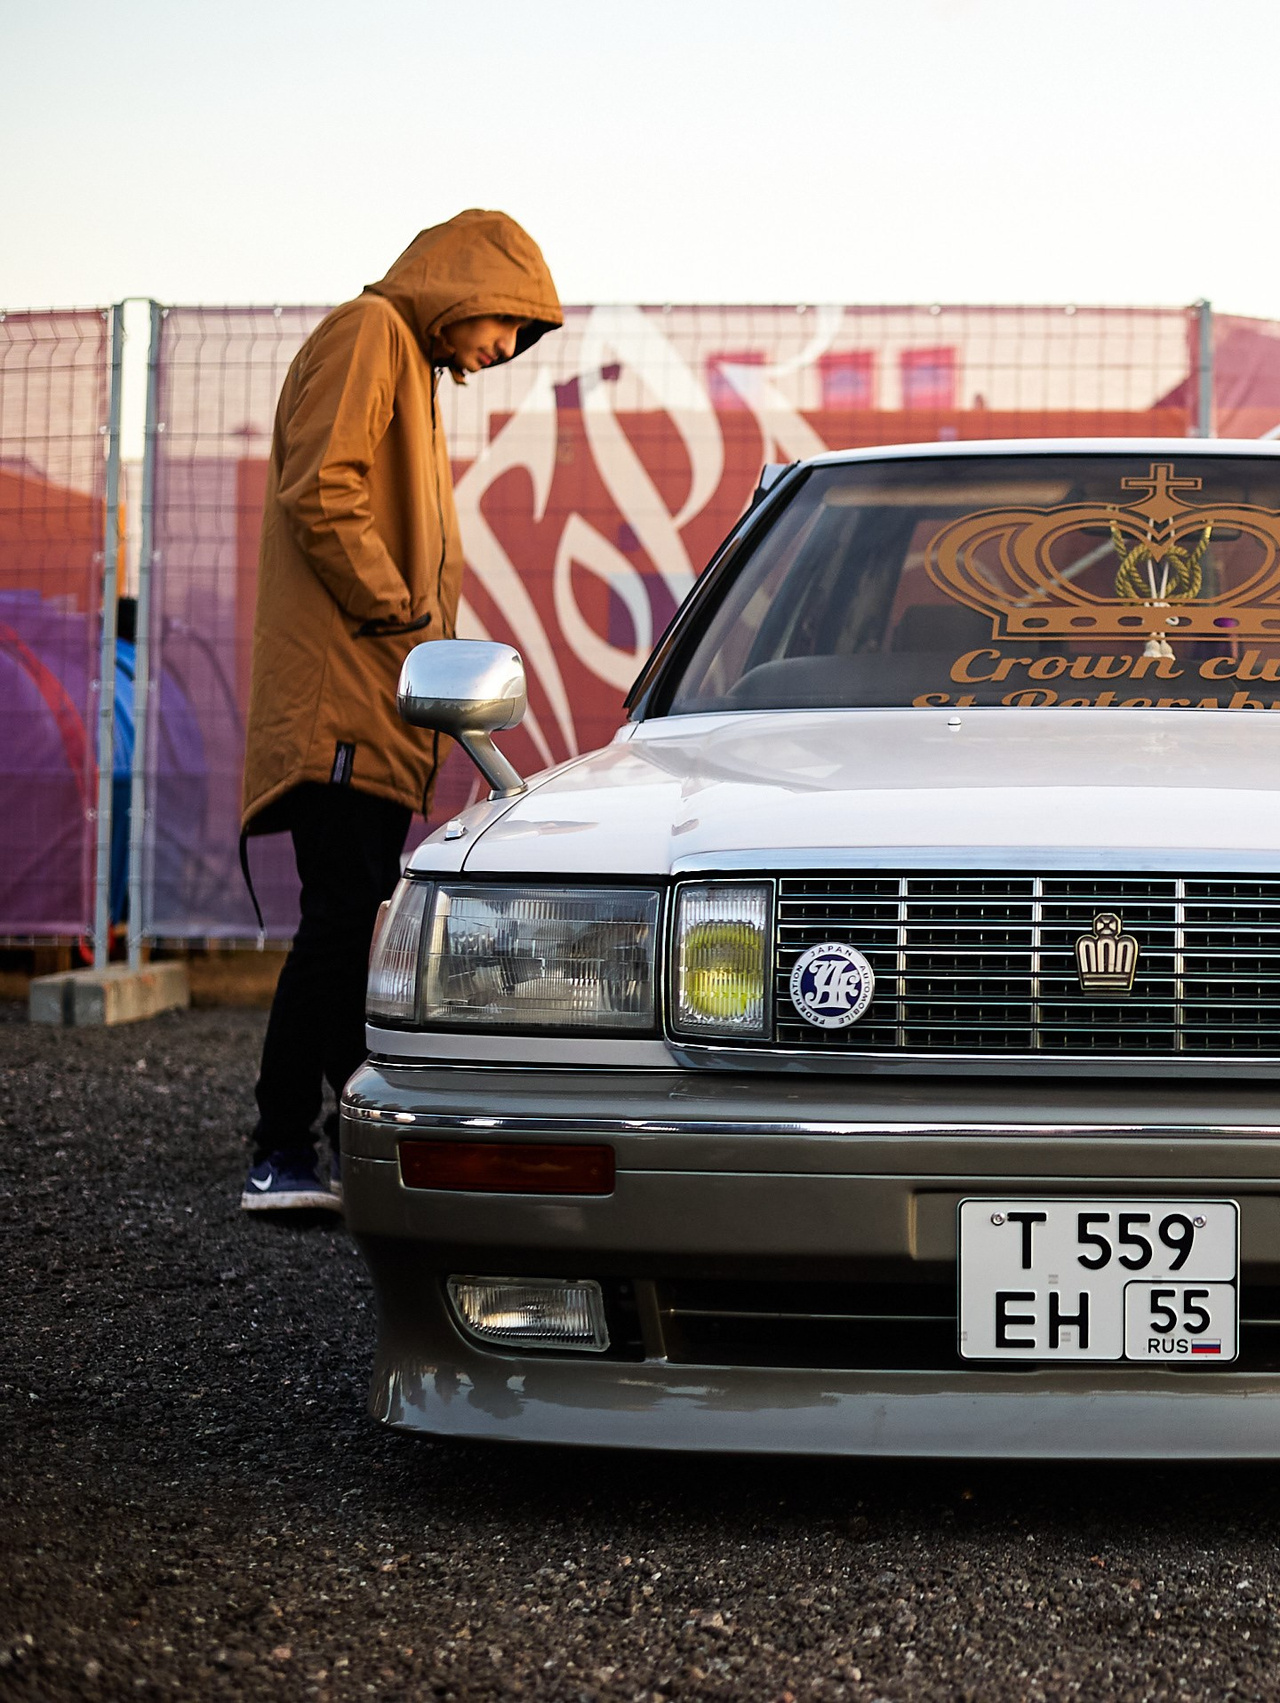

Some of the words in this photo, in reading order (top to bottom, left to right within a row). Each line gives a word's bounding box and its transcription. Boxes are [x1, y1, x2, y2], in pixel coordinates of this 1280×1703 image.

[950, 648, 1184, 683] Crown
[810, 945, 853, 958] JAPAN
[791, 964, 826, 1025] FEDERATION
[838, 965, 871, 1026] AUTOMOBILE
[1077, 1212, 1195, 1271] 559
[1150, 1289, 1211, 1334] 55
[1148, 1338, 1189, 1354] RUS
